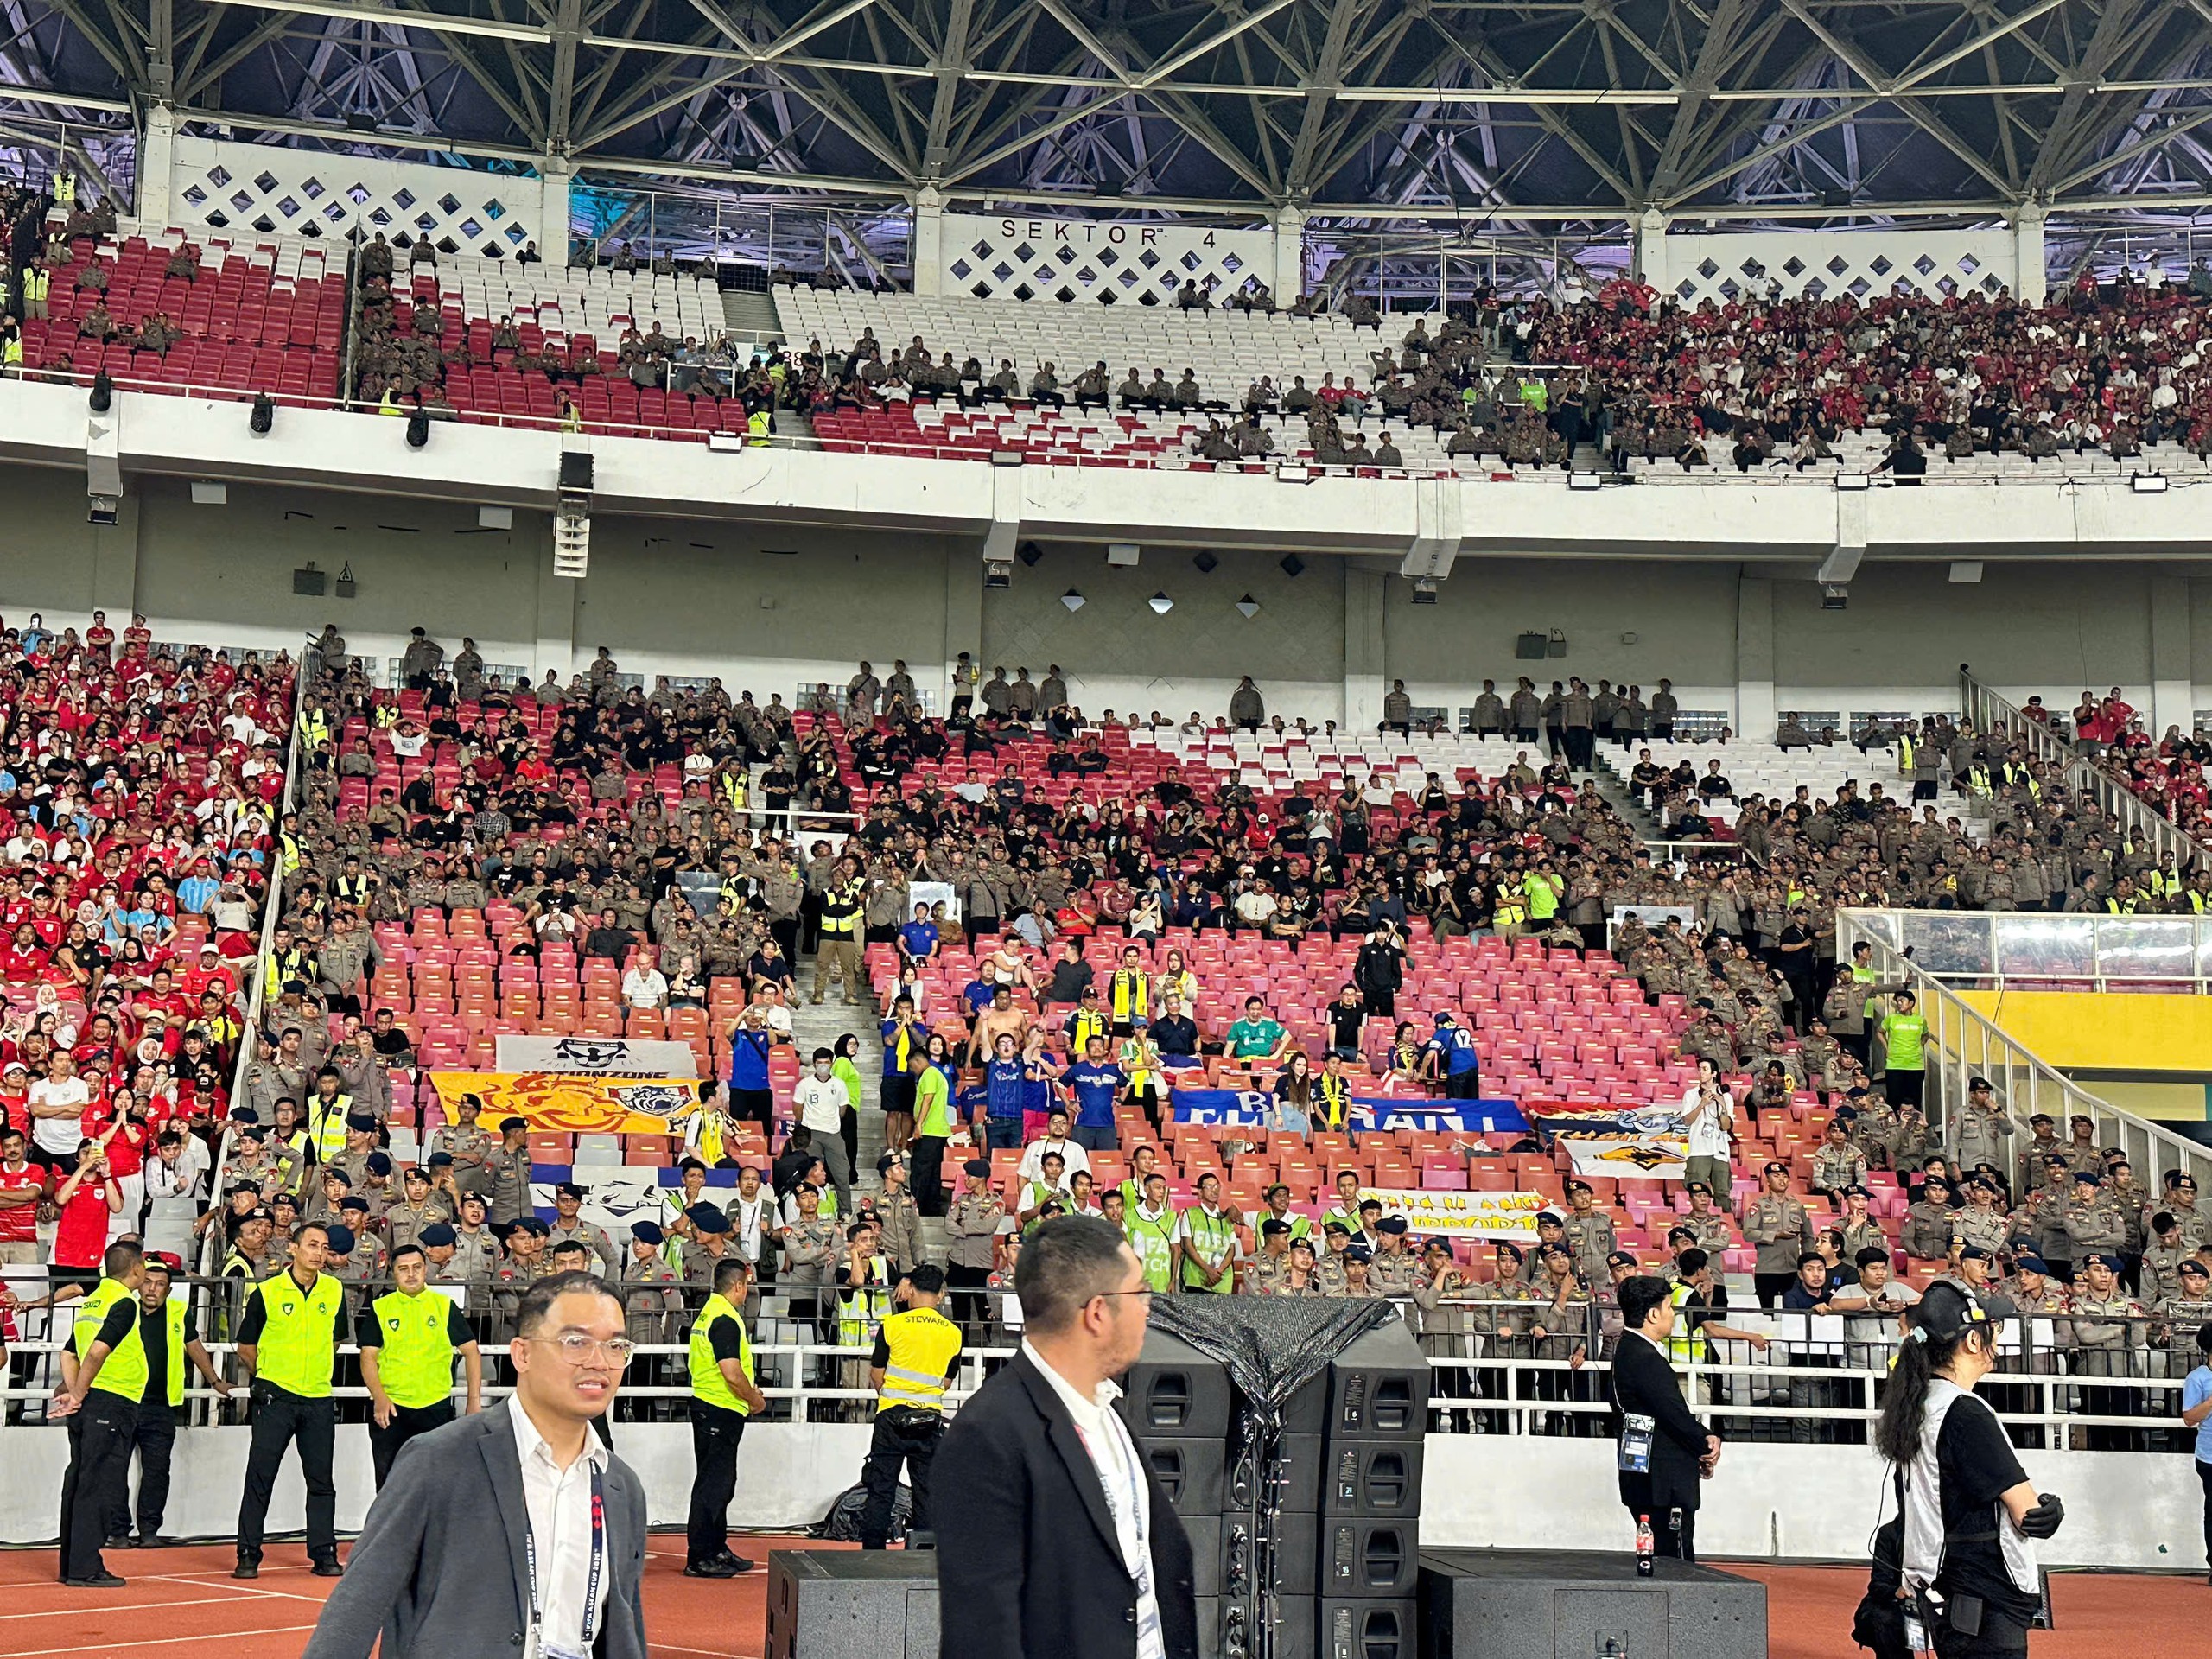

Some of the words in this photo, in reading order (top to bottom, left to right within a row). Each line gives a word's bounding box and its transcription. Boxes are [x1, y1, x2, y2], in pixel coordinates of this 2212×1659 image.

[1001, 219, 1156, 246] SEKTOR
[1202, 231, 1216, 249] 4
[809, 1093, 819, 1104] 13
[905, 1315, 950, 1328] STEWARD
